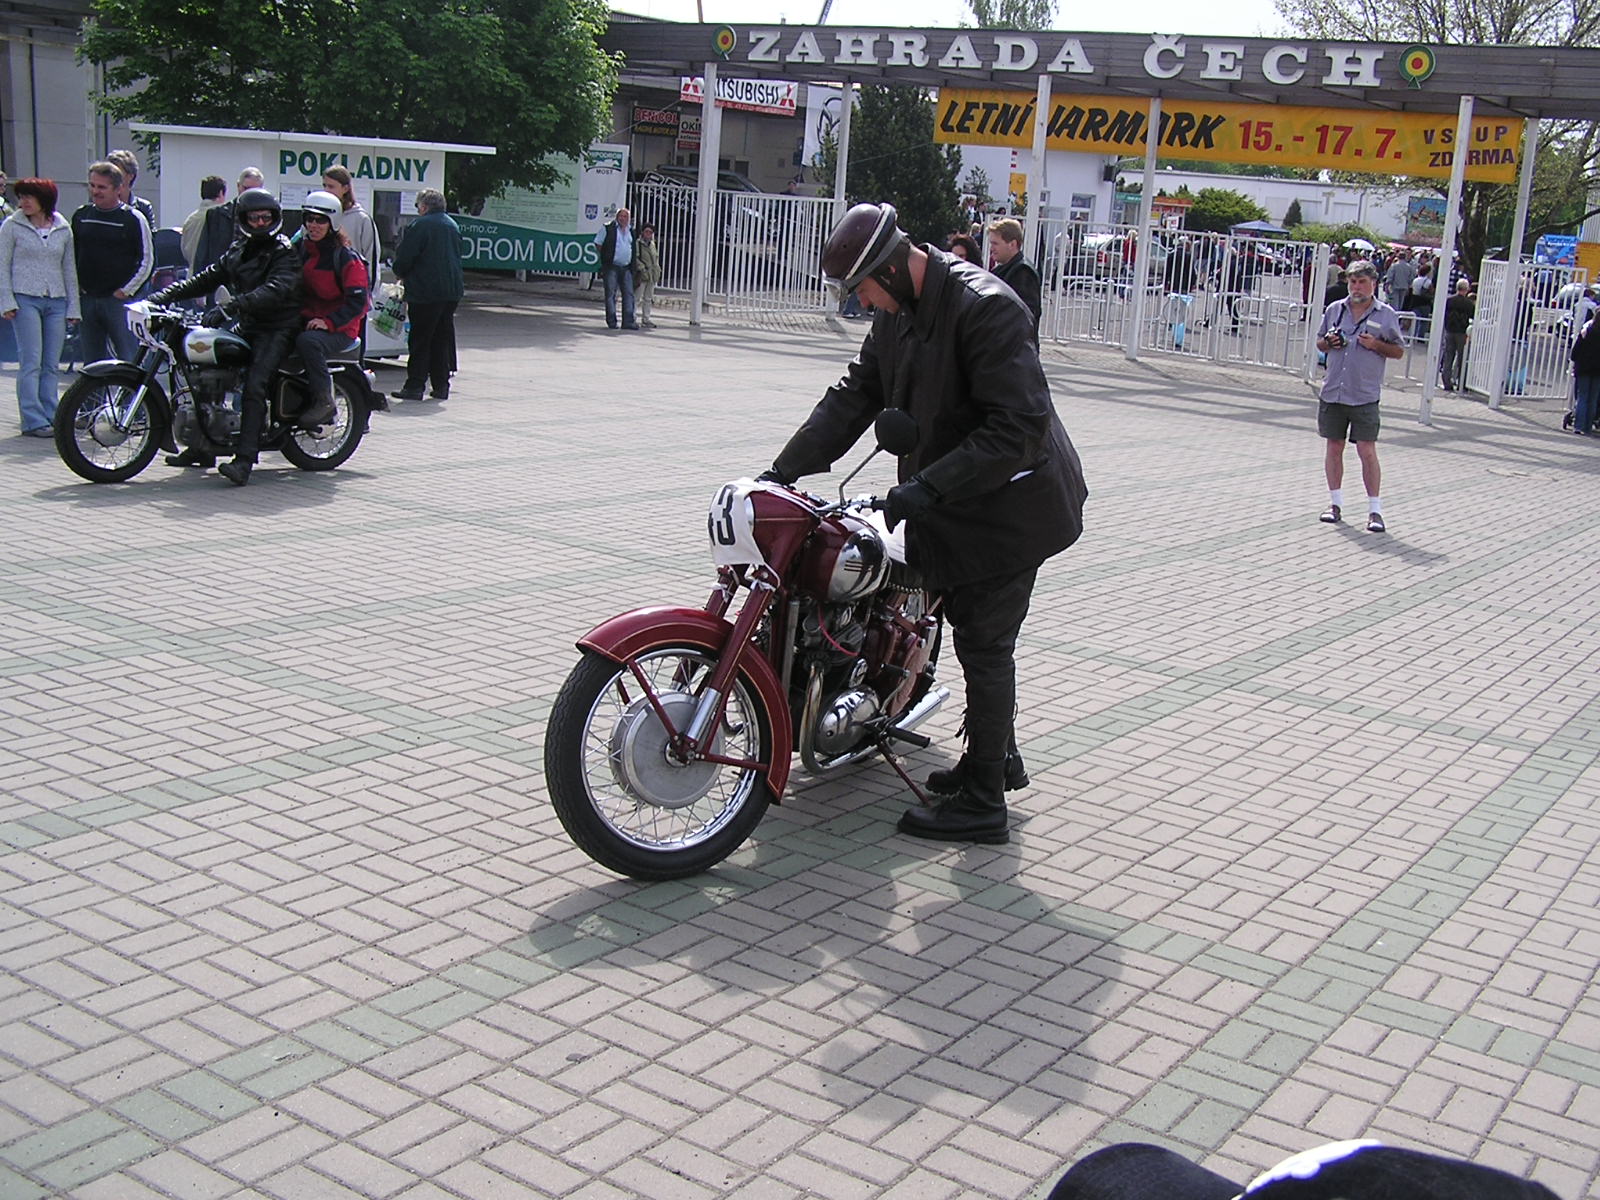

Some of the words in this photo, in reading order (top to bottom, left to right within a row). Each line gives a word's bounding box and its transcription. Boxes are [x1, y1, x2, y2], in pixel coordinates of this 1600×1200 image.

[748, 30, 1095, 74] ZAHRADA
[1143, 33, 1385, 87] ČECH
[702, 77, 779, 105] ITSUBISHI
[940, 96, 1038, 136] LETNÍ
[1423, 126, 1508, 144] VSUP
[279, 149, 431, 182] POKLADNY
[1428, 148, 1515, 167] ZDRMA
[458, 223, 499, 234] m-mo.cz
[461, 236, 534, 262] DROM
[544, 240, 599, 265] MOS
